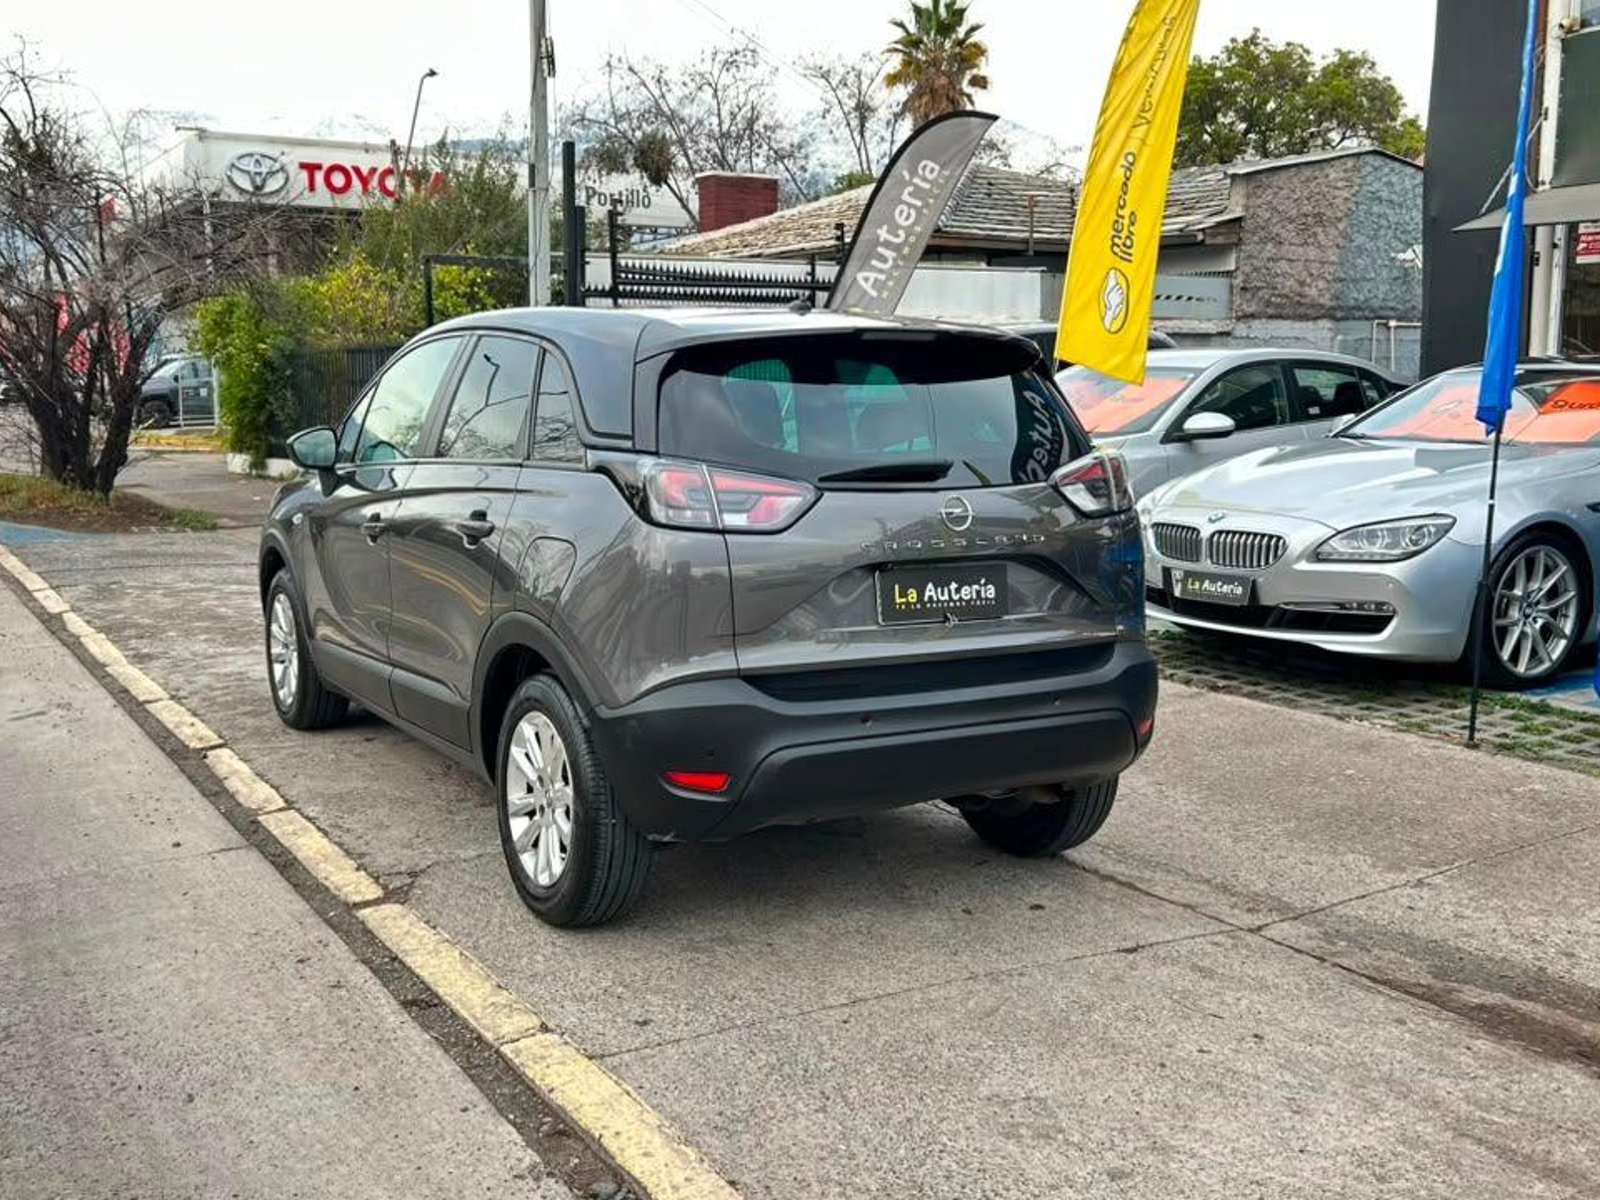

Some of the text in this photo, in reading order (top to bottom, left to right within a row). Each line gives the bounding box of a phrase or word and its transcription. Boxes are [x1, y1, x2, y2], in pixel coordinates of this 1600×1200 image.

[298, 162, 453, 200] TOYO
[1111, 152, 1136, 255] mercado
[856, 159, 941, 297] Autería
[1120, 211, 1137, 263] libre
[894, 577, 996, 603] La Autería
[1187, 577, 1200, 589] La
